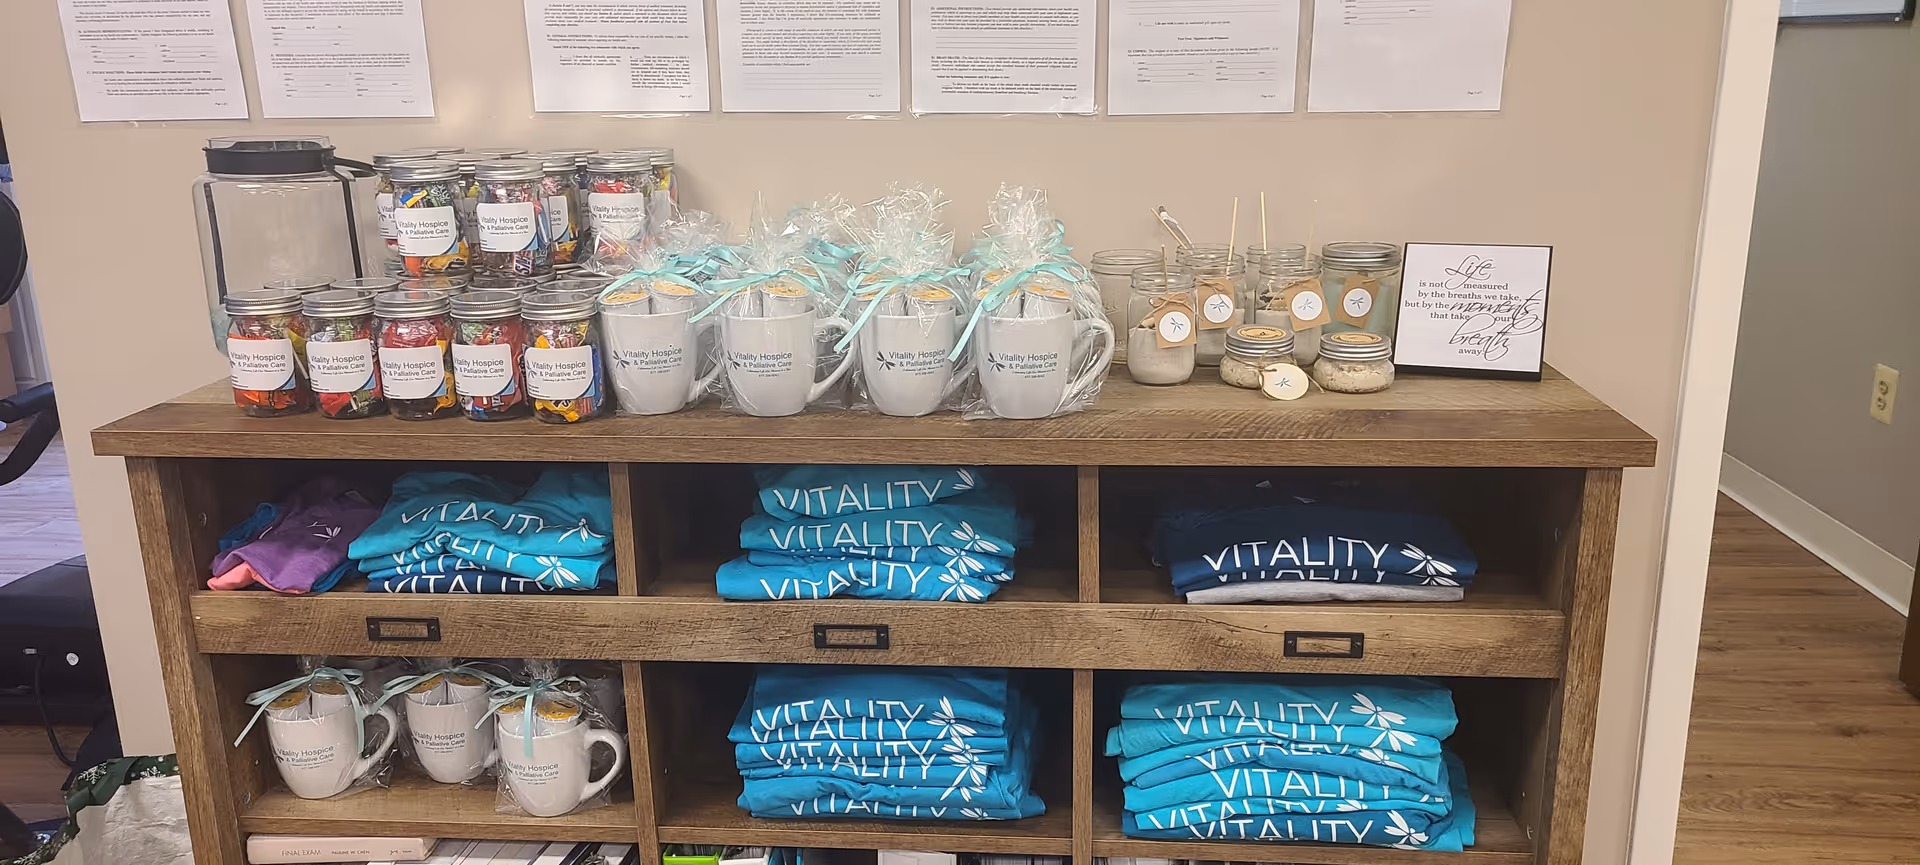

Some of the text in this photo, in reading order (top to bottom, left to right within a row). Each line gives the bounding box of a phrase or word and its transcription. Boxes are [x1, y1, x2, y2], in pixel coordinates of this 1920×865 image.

[399, 220, 448, 229] Vitality Hospice
[481, 216, 498, 225] Vitality
[500, 216, 528, 225] Hospice
[1444, 254, 1496, 290] Life
[1418, 290, 1429, 298] by
[1448, 291, 1482, 300] breaths
[1500, 293, 1522, 302] take,
[1422, 301, 1433, 309] by
[1450, 289, 1544, 331] moments
[1449, 313, 1512, 361] breath
[231, 352, 286, 362] Vitality Hospice
[622, 348, 682, 359] Vitality Hospice
[734, 352, 792, 362] Vitality Hospice
[889, 349, 945, 360] Vitality Hospice
[999, 352, 1058, 363] Vitality Hospice
[311, 354, 364, 365] Vitality Hospice
[454, 358, 503, 368] Vitality Hospice
[383, 361, 435, 370] Vitality Hospice
[532, 361, 586, 371] Vitality Hospice
[773, 479, 942, 515] VITALITY
[769, 520, 942, 550] VITALITY
[1202, 536, 1390, 571] VITALITY
[760, 561, 931, 600] VITALITY
[413, 730, 465, 741] Vitality Hospice
[277, 746, 334, 757] Vitality Hospice
[528, 763, 558, 772] Hospice
